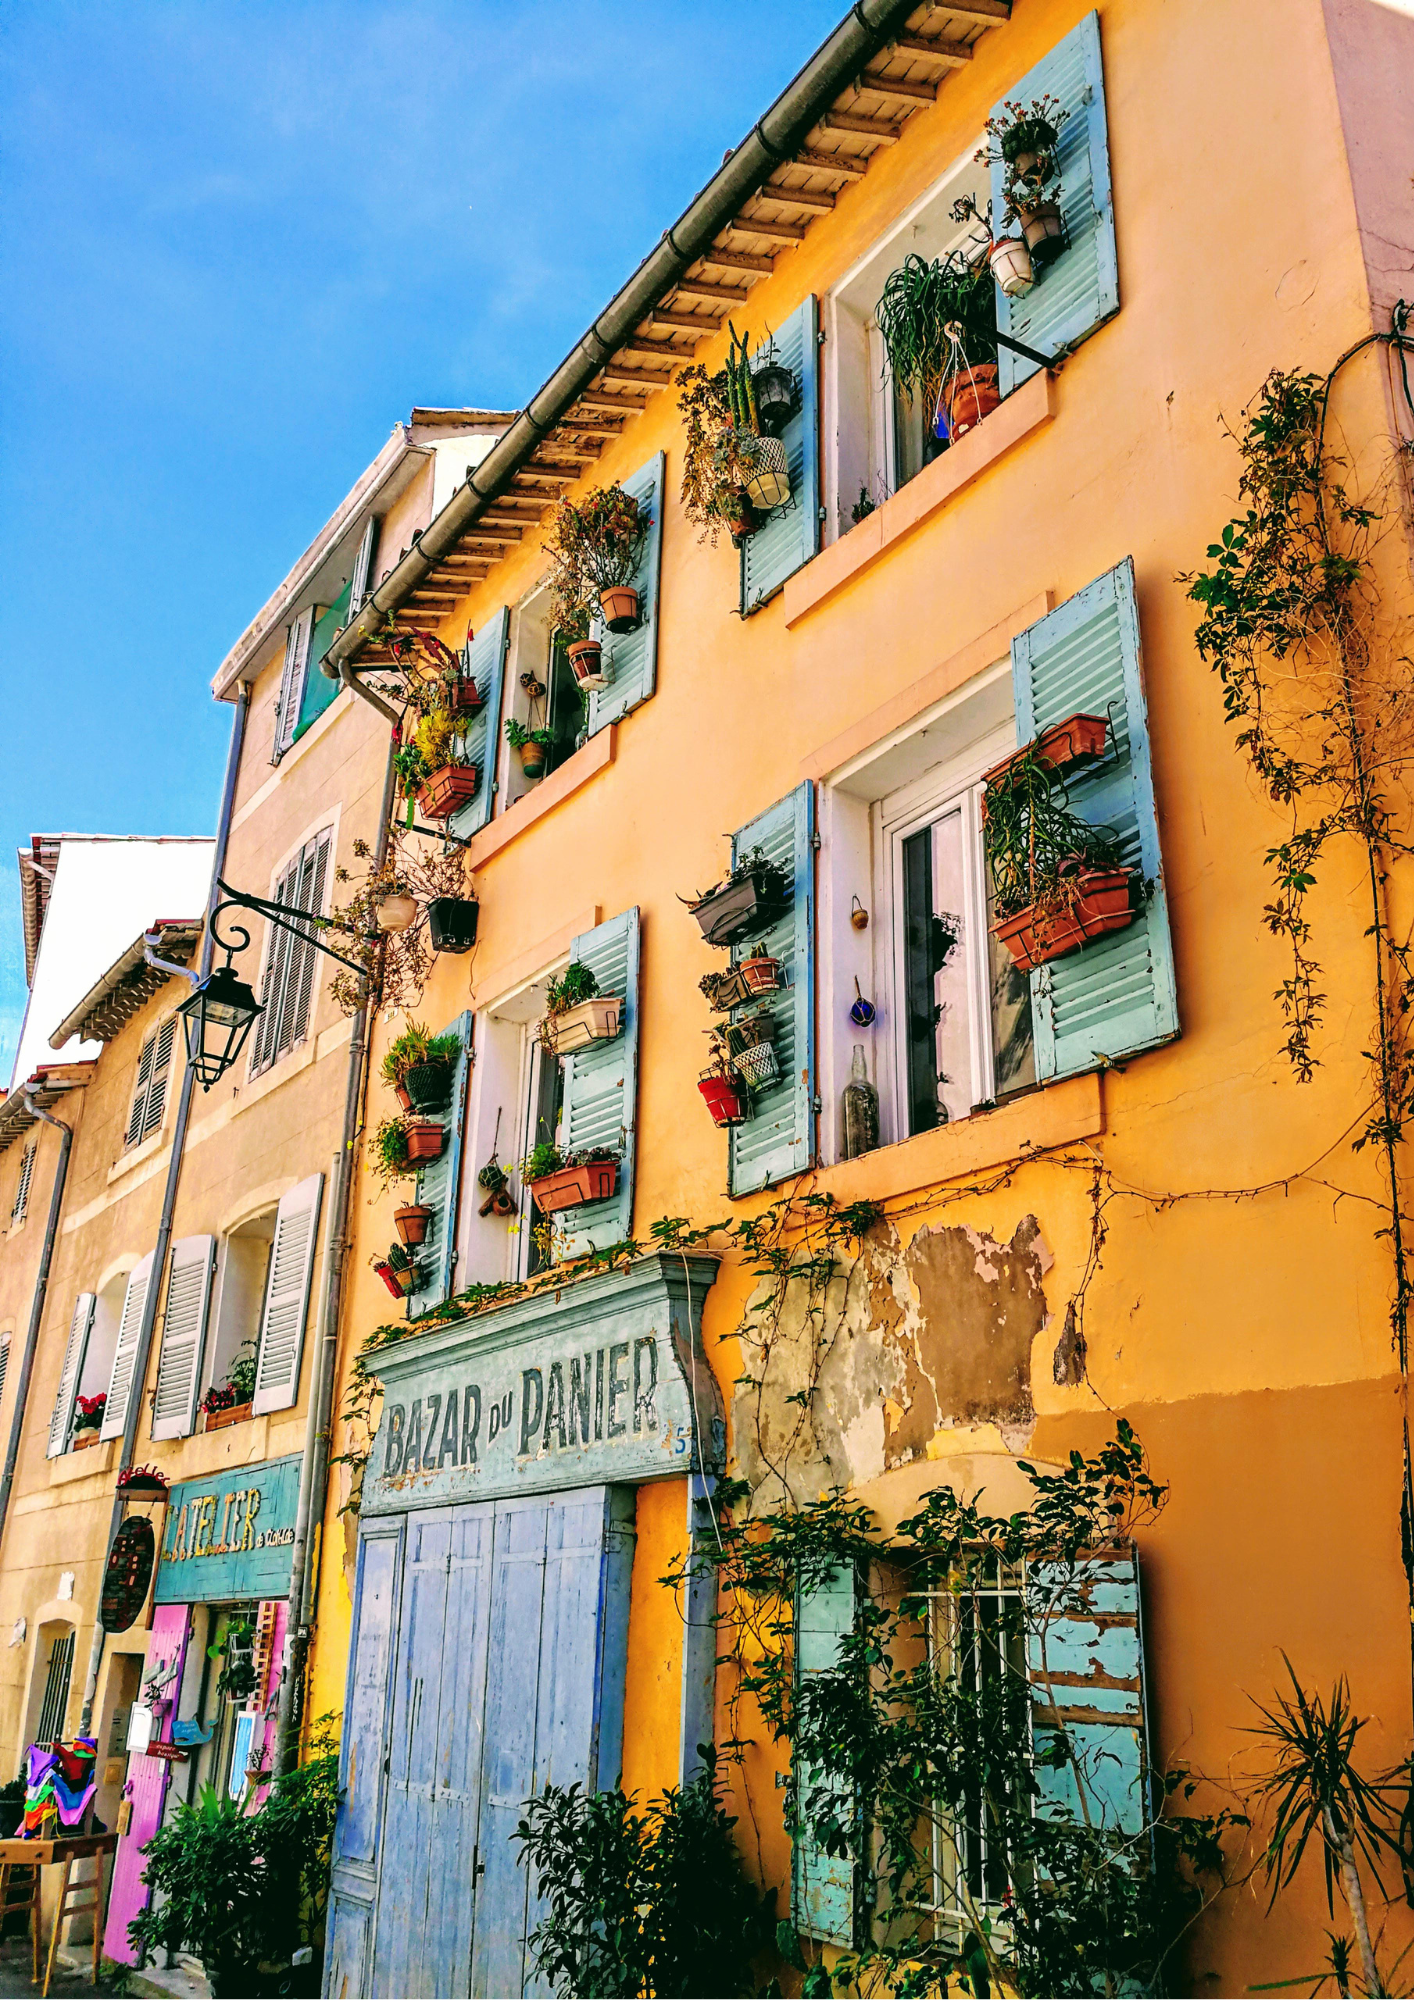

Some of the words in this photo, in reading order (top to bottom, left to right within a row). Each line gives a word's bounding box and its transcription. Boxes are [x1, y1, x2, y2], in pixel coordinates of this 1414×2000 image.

[383, 1385, 481, 1477] BAZAR
[488, 1391, 513, 1444] DU
[517, 1337, 658, 1456] PANIER
[675, 1427, 686, 1454] 5
[162, 1488, 260, 1562] L'ATELIER
